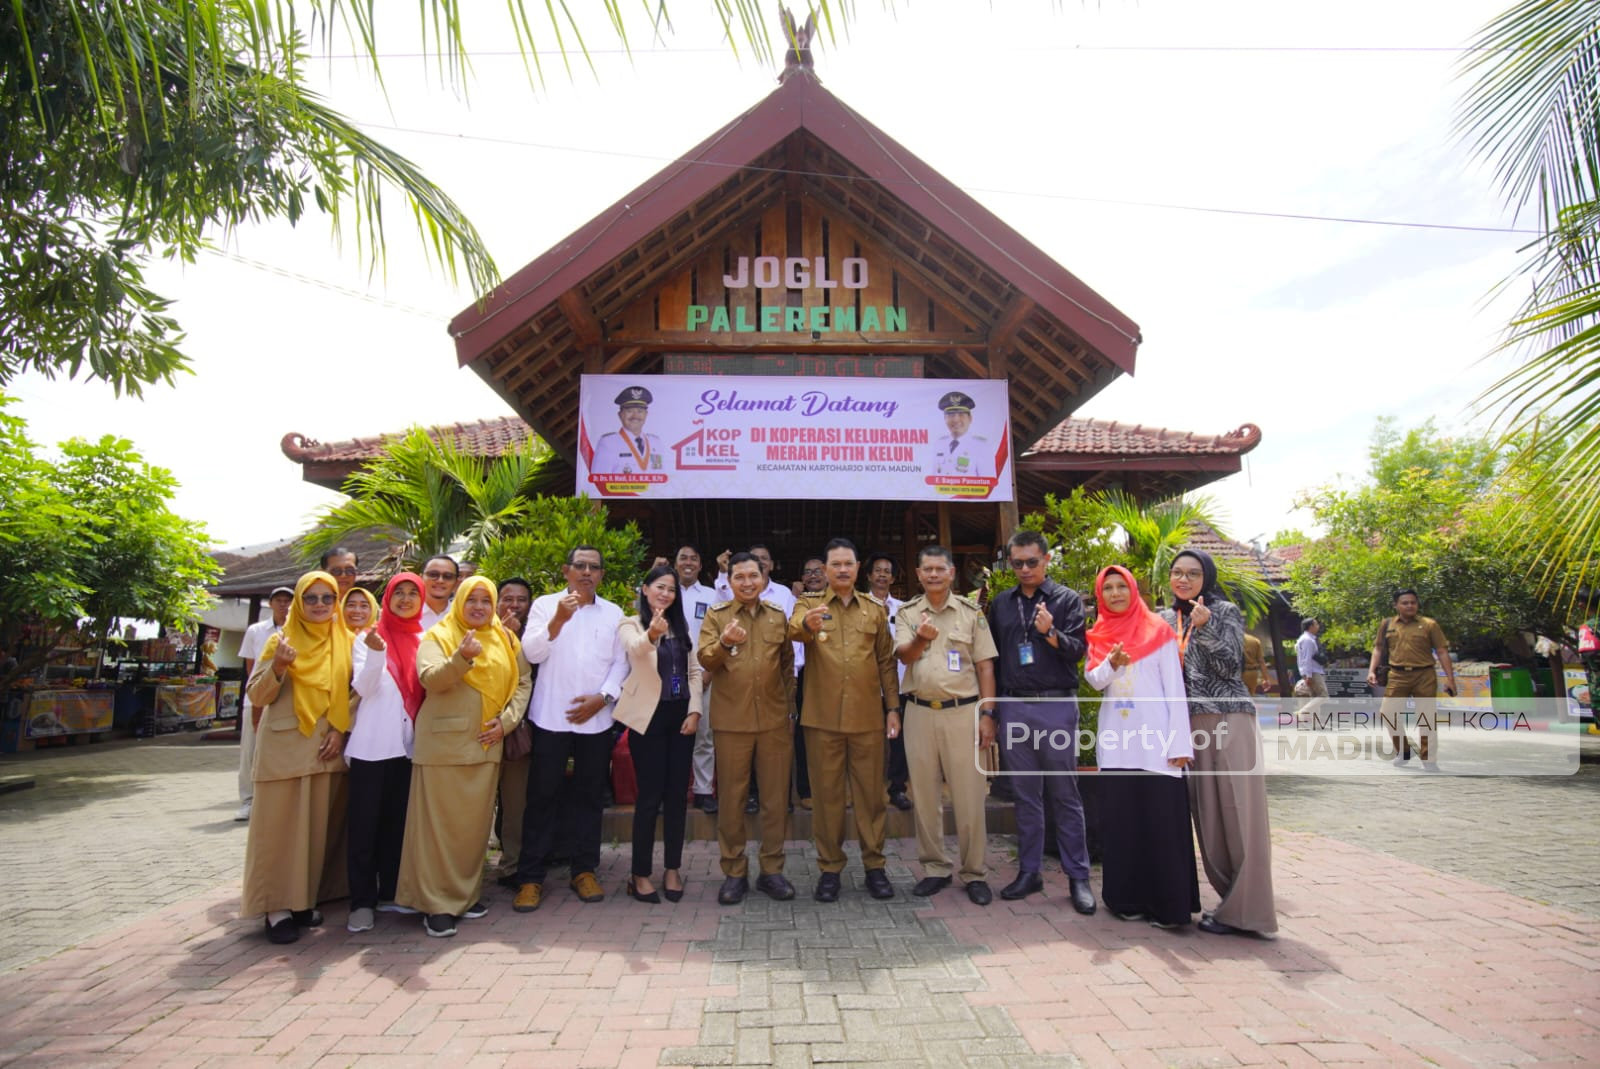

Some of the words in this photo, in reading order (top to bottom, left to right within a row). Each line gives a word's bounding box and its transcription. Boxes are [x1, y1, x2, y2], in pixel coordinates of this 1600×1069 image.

[723, 256, 869, 289] JOGLO
[687, 305, 908, 333] PALEREMAN
[695, 389, 797, 416] Selamat
[801, 390, 900, 418] Datang
[706, 428, 742, 441] KOP
[750, 427, 766, 443] DI
[769, 427, 841, 443] KOPERASI
[844, 428, 929, 444] KELURAHAN
[706, 444, 740, 457] KEL
[766, 445, 818, 461] MERAH
[821, 445, 865, 461] PUTIH
[868, 446, 914, 462] KELUN
[757, 463, 807, 472] KECAMATAN
[809, 464, 863, 472] KARTOHARJO
[865, 464, 887, 472] KOTA
[888, 465, 922, 473] MADIUN
